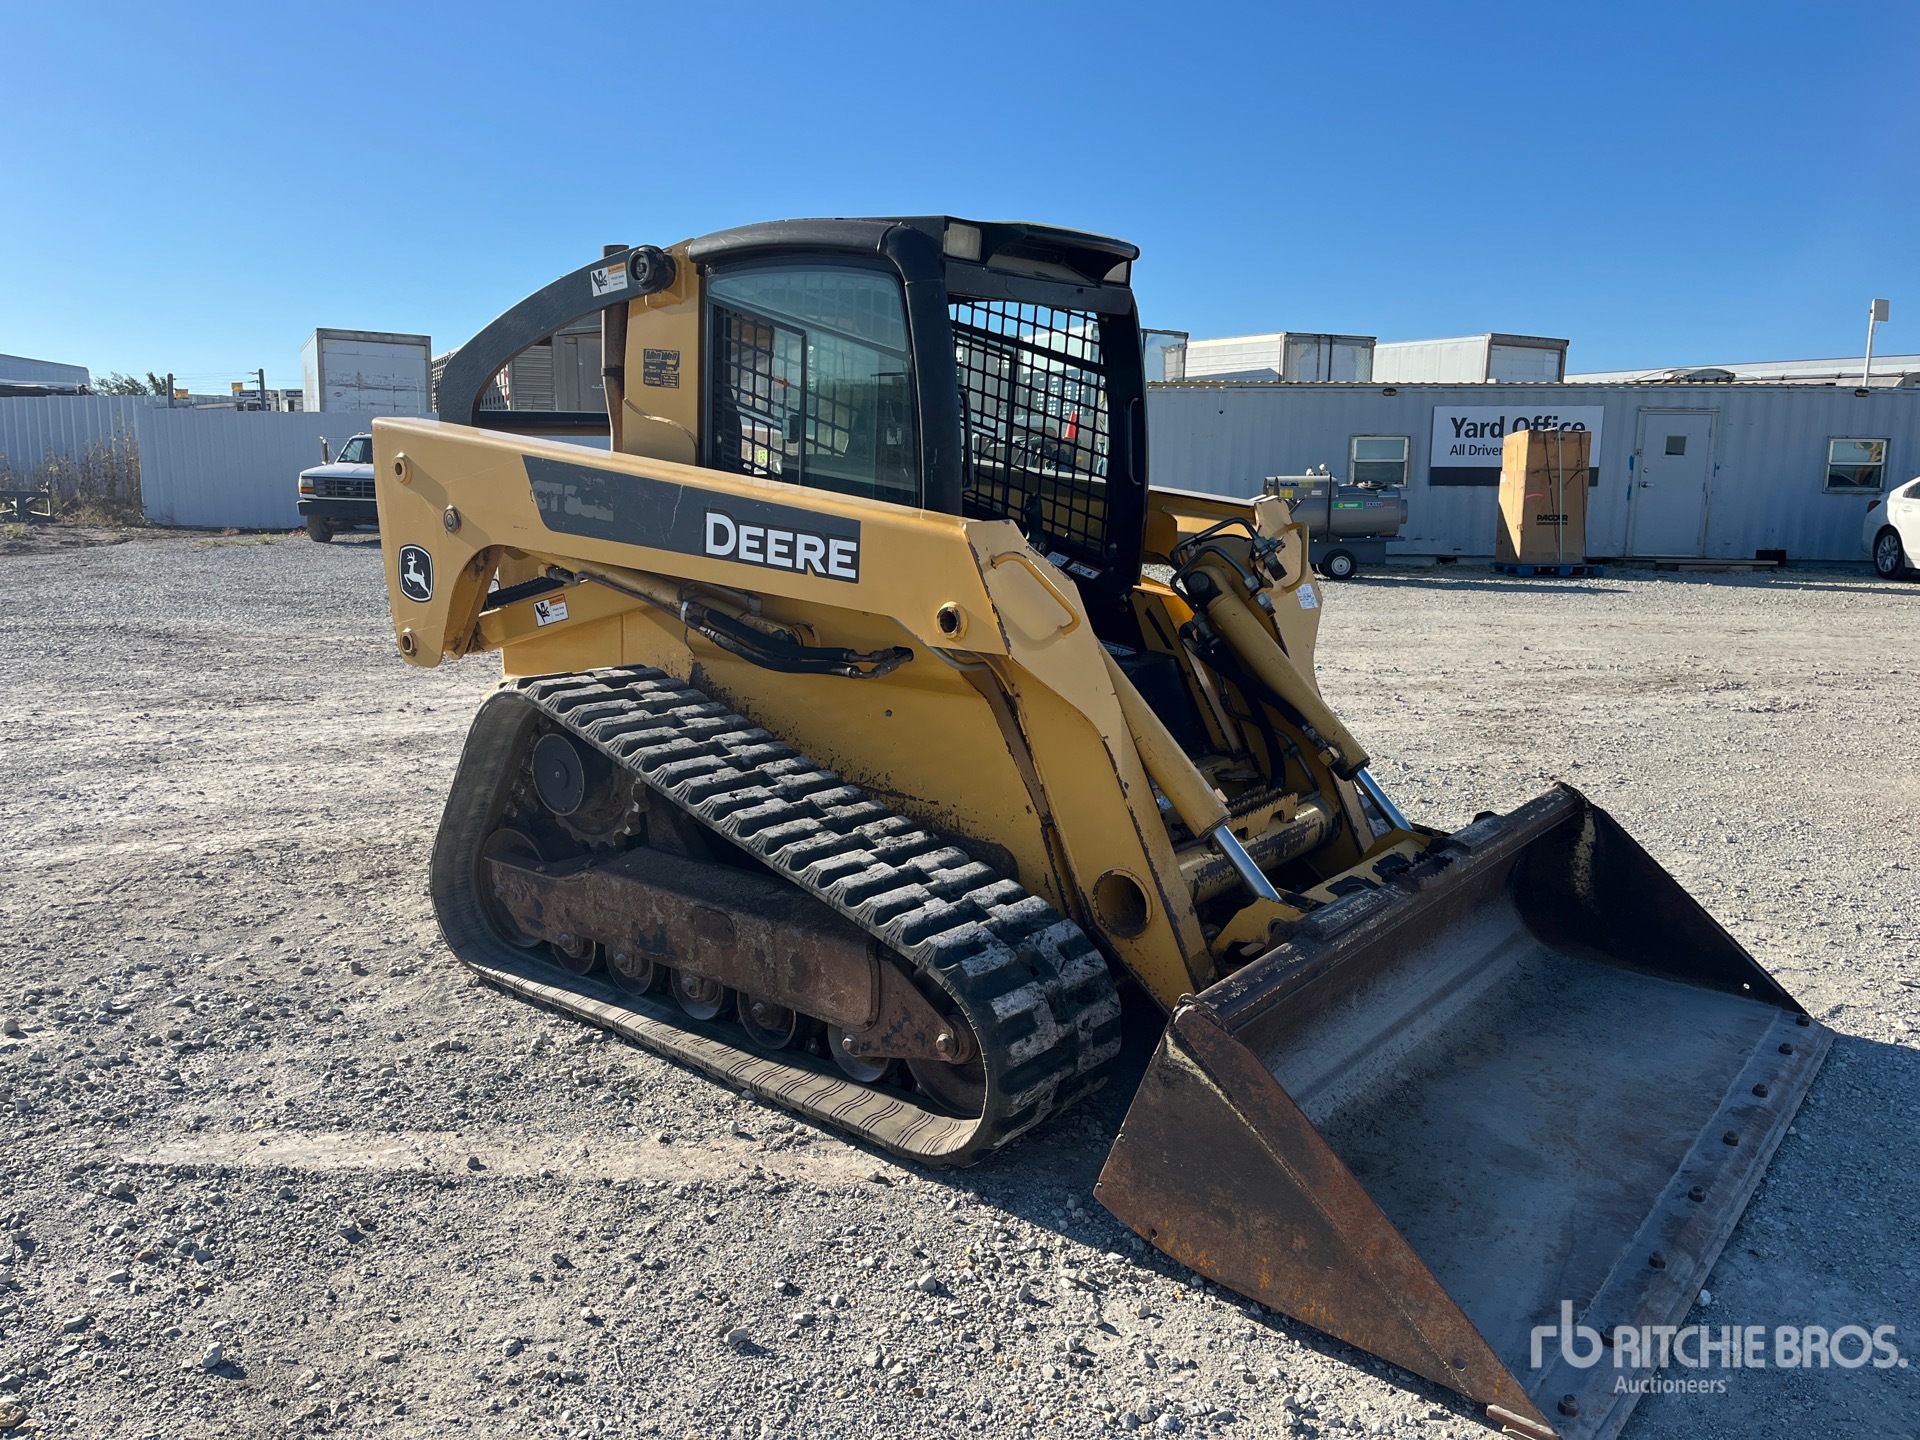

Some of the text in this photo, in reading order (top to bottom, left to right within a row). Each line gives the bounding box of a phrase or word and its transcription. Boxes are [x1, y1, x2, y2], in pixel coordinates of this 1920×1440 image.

[1450, 415, 1505, 439] Yard
[1450, 444, 1465, 456] All
[706, 512, 857, 578] DEERE
